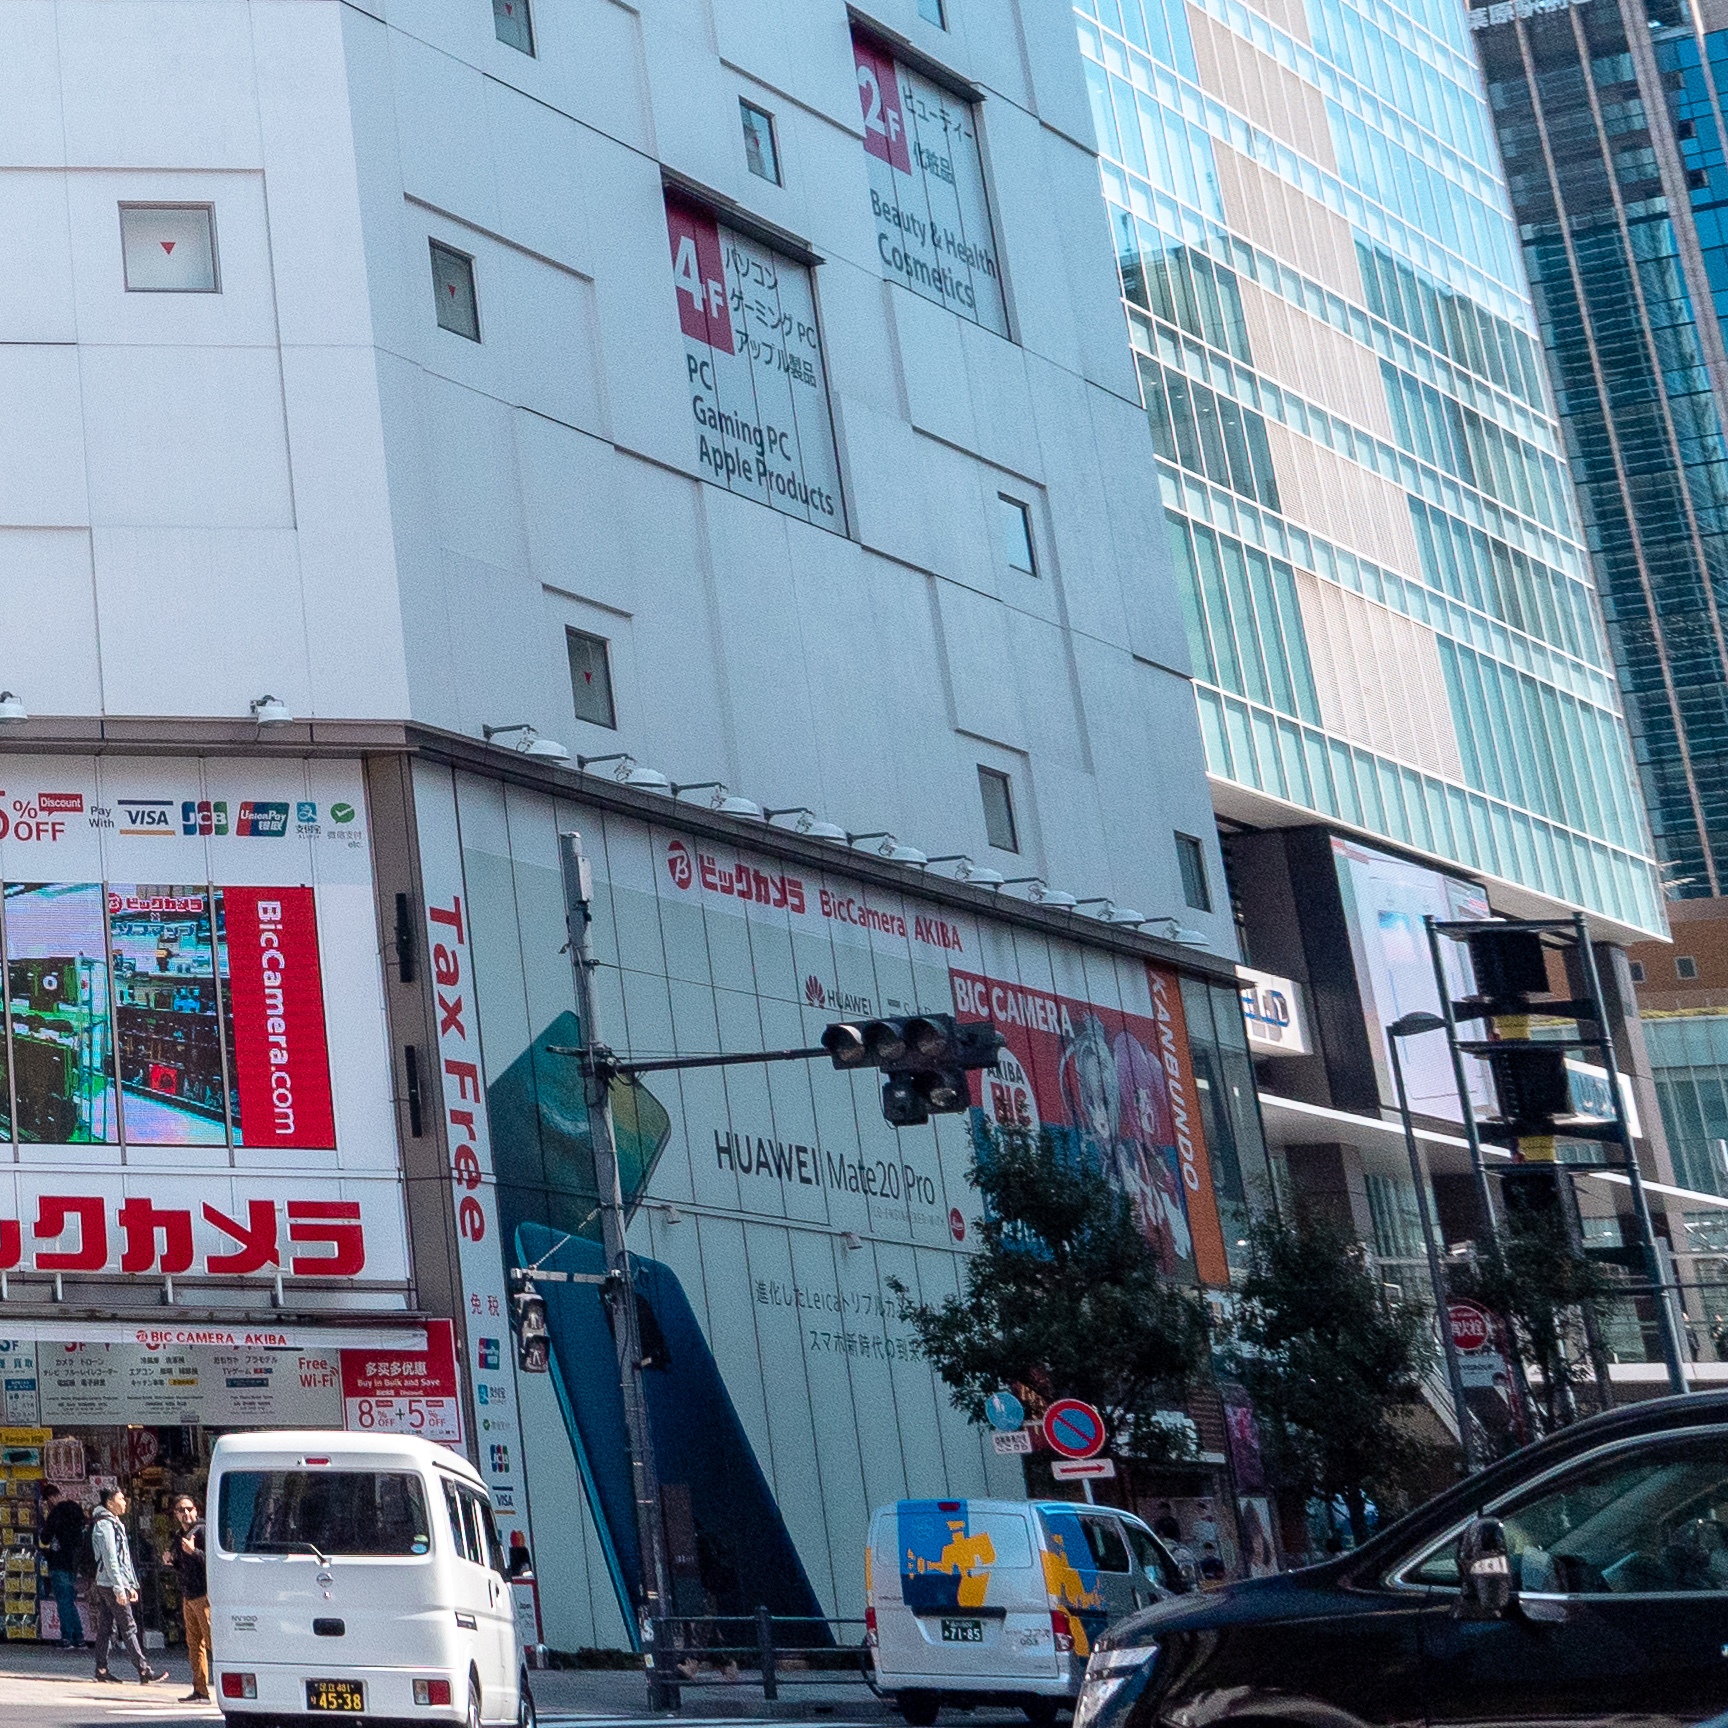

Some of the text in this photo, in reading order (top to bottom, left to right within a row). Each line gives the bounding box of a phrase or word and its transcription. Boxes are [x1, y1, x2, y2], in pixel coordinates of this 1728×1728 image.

[855, 63, 902, 143] 2F
[903, 80, 974, 140] ビューティー
[912, 140, 955, 185] 化粧品
[870, 188, 996, 280] Beauty & Health
[674, 236, 727, 320] 4F
[725, 246, 778, 292] パソコン
[877, 235, 975, 310] Cosmetics
[686, 354, 713, 391] PC
[736, 329, 817, 388] アップル製品
[692, 394, 791, 462] Gaming PC
[699, 434, 834, 518] Apple Products
[40, 795, 81, 809] Discount
[89, 816, 115, 829] With
[90, 805, 112, 819] Pay
[122, 808, 169, 826] VISA
[182, 802, 228, 836] JCB
[239, 808, 287, 822] UnionPay
[14, 821, 65, 842] OFF
[697, 851, 806, 915] ビックカメラ
[819, 888, 964, 954] BicCamera AKIBA
[256, 900, 295, 1135] BicCamera.com
[826, 986, 873, 1017] HUAWEI
[954, 976, 990, 1017] BIC
[992, 985, 1076, 1040] CAMERA
[430, 895, 485, 1242] Tax Free
[1150, 970, 1199, 1192] KANBUNDO
[714, 1129, 822, 1187] HUAWEI
[905, 1164, 936, 1206] Pro
[150, 1331, 287, 1346] BIC CAMERA AKIBA
[298, 1357, 327, 1370] Free
[300, 1375, 333, 1388] Wi-Fi
[495, 1492, 514, 1508] VISA
[319, 1692, 362, 1710] 45-38
